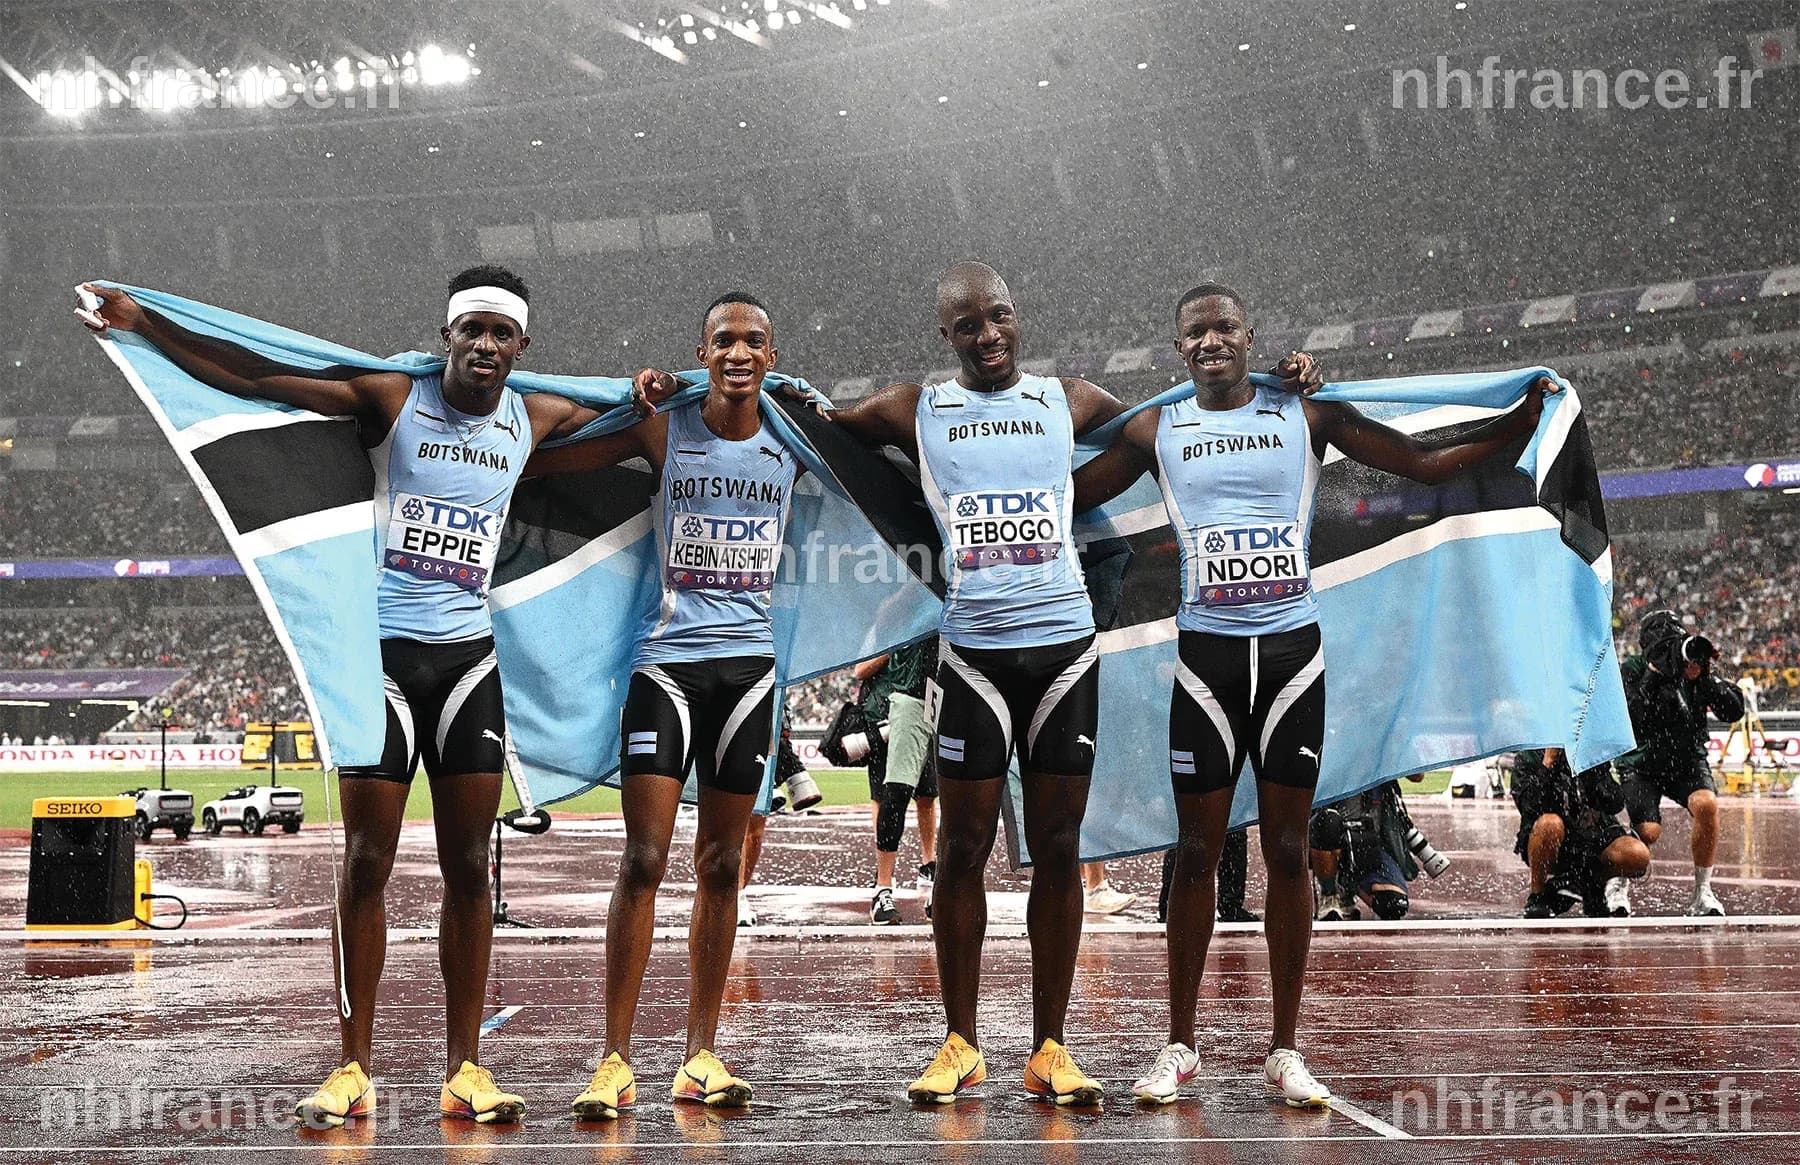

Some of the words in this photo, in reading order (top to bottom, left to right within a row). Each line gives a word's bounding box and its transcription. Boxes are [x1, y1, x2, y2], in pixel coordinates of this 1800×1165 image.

[949, 421, 1046, 442] BOTSWANA
[418, 442, 508, 472] BOTSWANA
[1183, 434, 1284, 461] BOTSWANA
[673, 477, 782, 506] BOTSWANA
[977, 492, 1049, 514] TDK
[426, 501, 492, 537] TDK
[704, 518, 770, 541] TDK
[955, 519, 1054, 545] TEBOGO
[403, 527, 482, 564] EPPIE
[1224, 526, 1295, 551] TDK
[674, 543, 773, 569] KEBINATSHIPI
[1207, 554, 1298, 583] NDORI
[89, 749, 187, 761] HONDA
[47, 803, 103, 814] SEIKO
